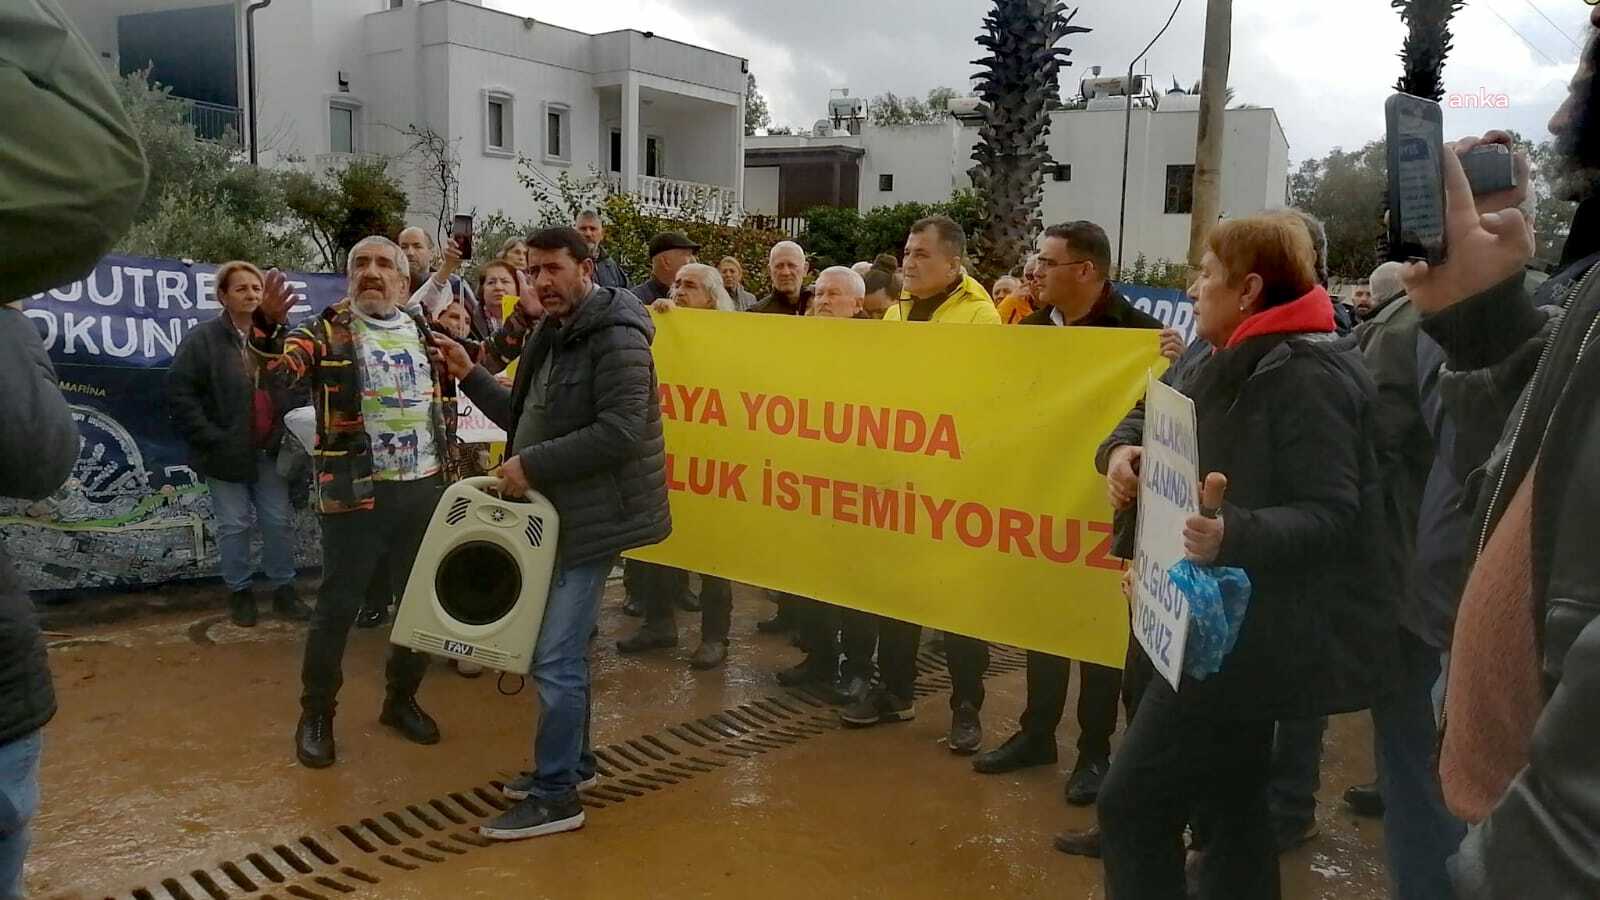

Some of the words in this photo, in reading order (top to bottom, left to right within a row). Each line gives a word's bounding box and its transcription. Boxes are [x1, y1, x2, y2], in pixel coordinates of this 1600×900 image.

[22, 309, 199, 358] OKUN
[657, 383, 728, 428] AYA
[740, 391, 961, 459] YOLUNDA
[665, 453, 749, 503] LUK
[761, 458, 1129, 572] İSTEMİYORUZ
[447, 641, 471, 655] FAV
